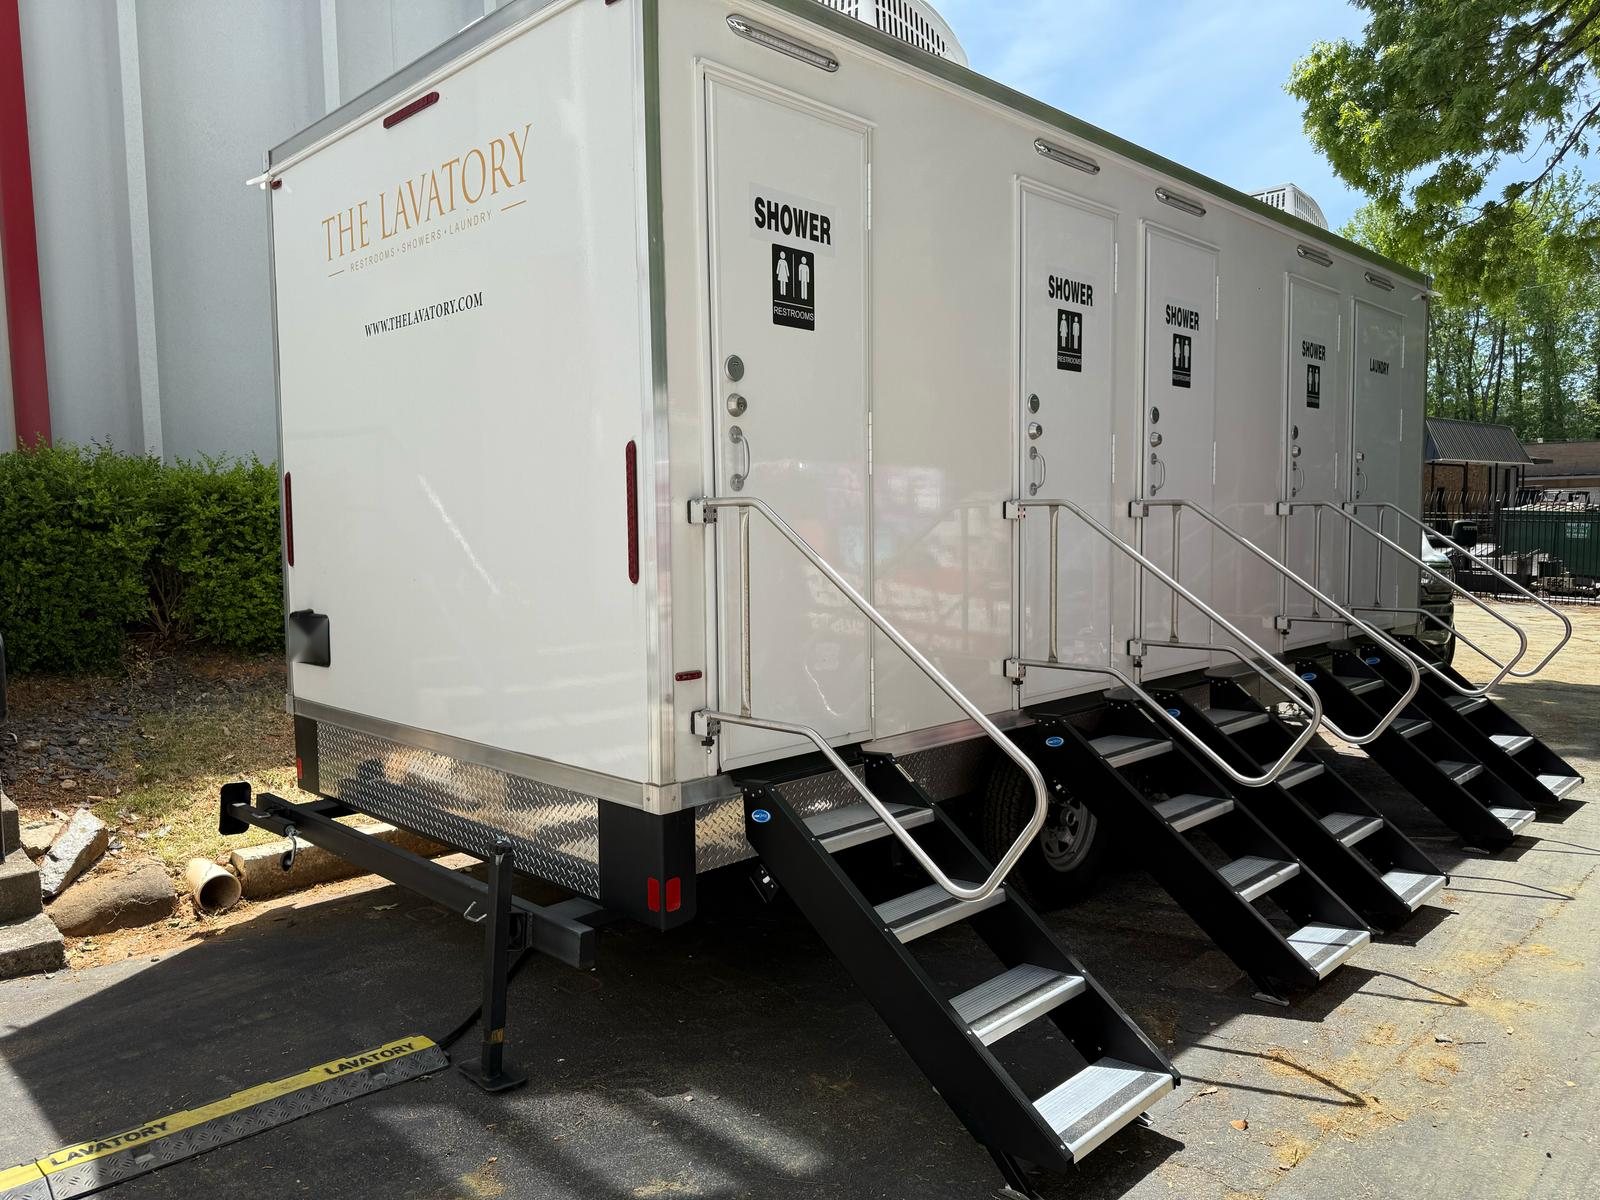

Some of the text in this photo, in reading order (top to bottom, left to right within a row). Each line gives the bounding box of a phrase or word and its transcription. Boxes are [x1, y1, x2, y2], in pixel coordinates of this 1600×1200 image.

[322, 124, 532, 262] THE LAVATORY
[754, 196, 831, 246] SHOWER
[350, 210, 492, 272] RESTROOMS SHOWERS LAUNDRY
[1048, 275, 1093, 307] SHOWER
[364, 291, 483, 337] WWW.THELAVATORY.COM
[773, 306, 814, 321] RESTROOMS
[1165, 304, 1199, 331] SHOWER
[1302, 340, 1326, 361] SHOWER
[324, 1042, 414, 1075] LAVATORY
[51, 1122, 168, 1166] LAVATORY
